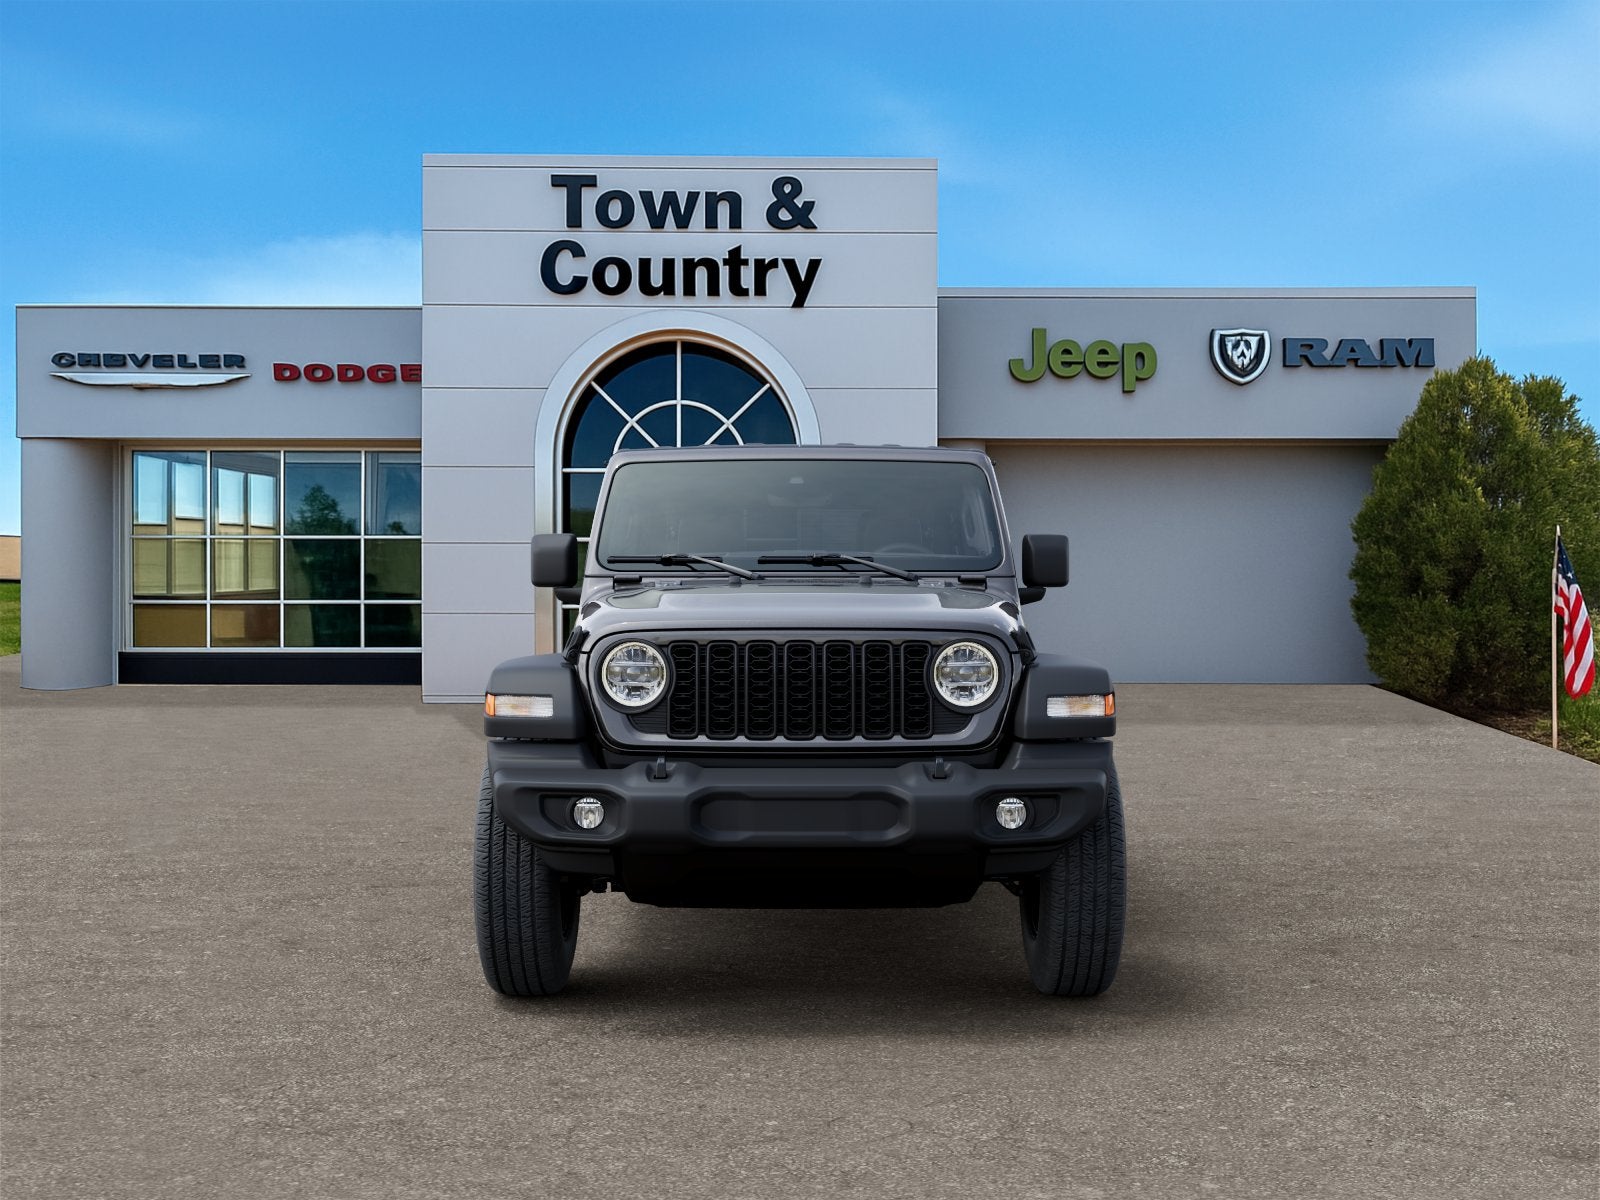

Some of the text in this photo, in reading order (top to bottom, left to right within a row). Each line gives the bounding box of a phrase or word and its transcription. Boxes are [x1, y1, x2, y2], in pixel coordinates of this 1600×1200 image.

[550, 174, 818, 229] Town &
[540, 239, 822, 308] Country
[273, 363, 422, 383] DODGE
[1008, 327, 1157, 392] Jeep
[1282, 337, 1435, 368] RAM
